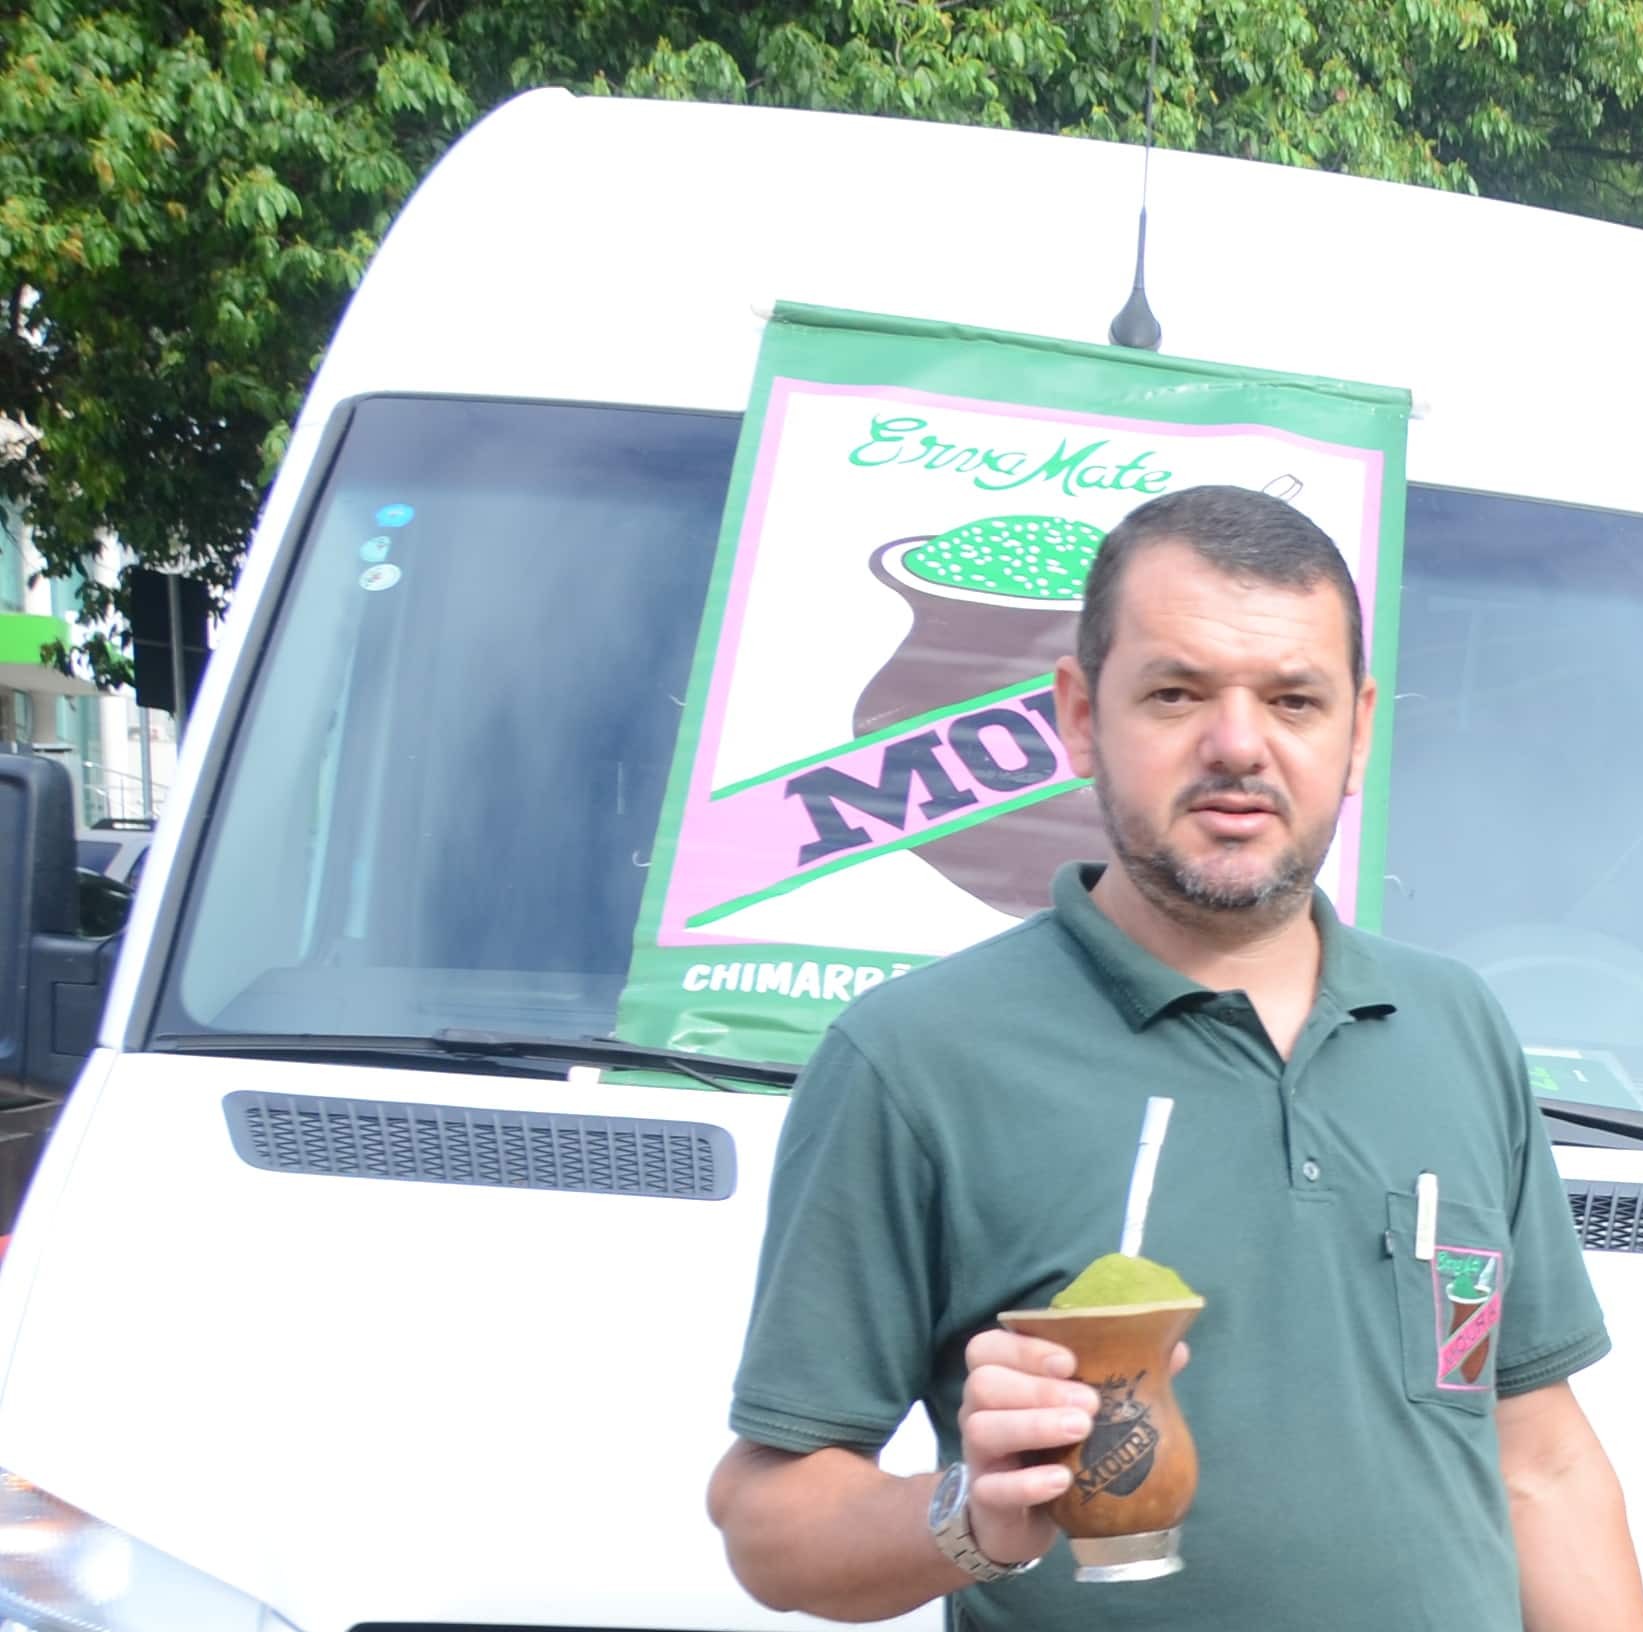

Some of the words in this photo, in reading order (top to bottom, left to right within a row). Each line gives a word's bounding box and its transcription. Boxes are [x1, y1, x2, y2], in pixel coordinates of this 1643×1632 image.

[848, 413, 1027, 476] Erva
[973, 437, 1172, 497] Mate
[784, 688, 1060, 867] MO
[682, 961, 912, 1001] CHIMARR
